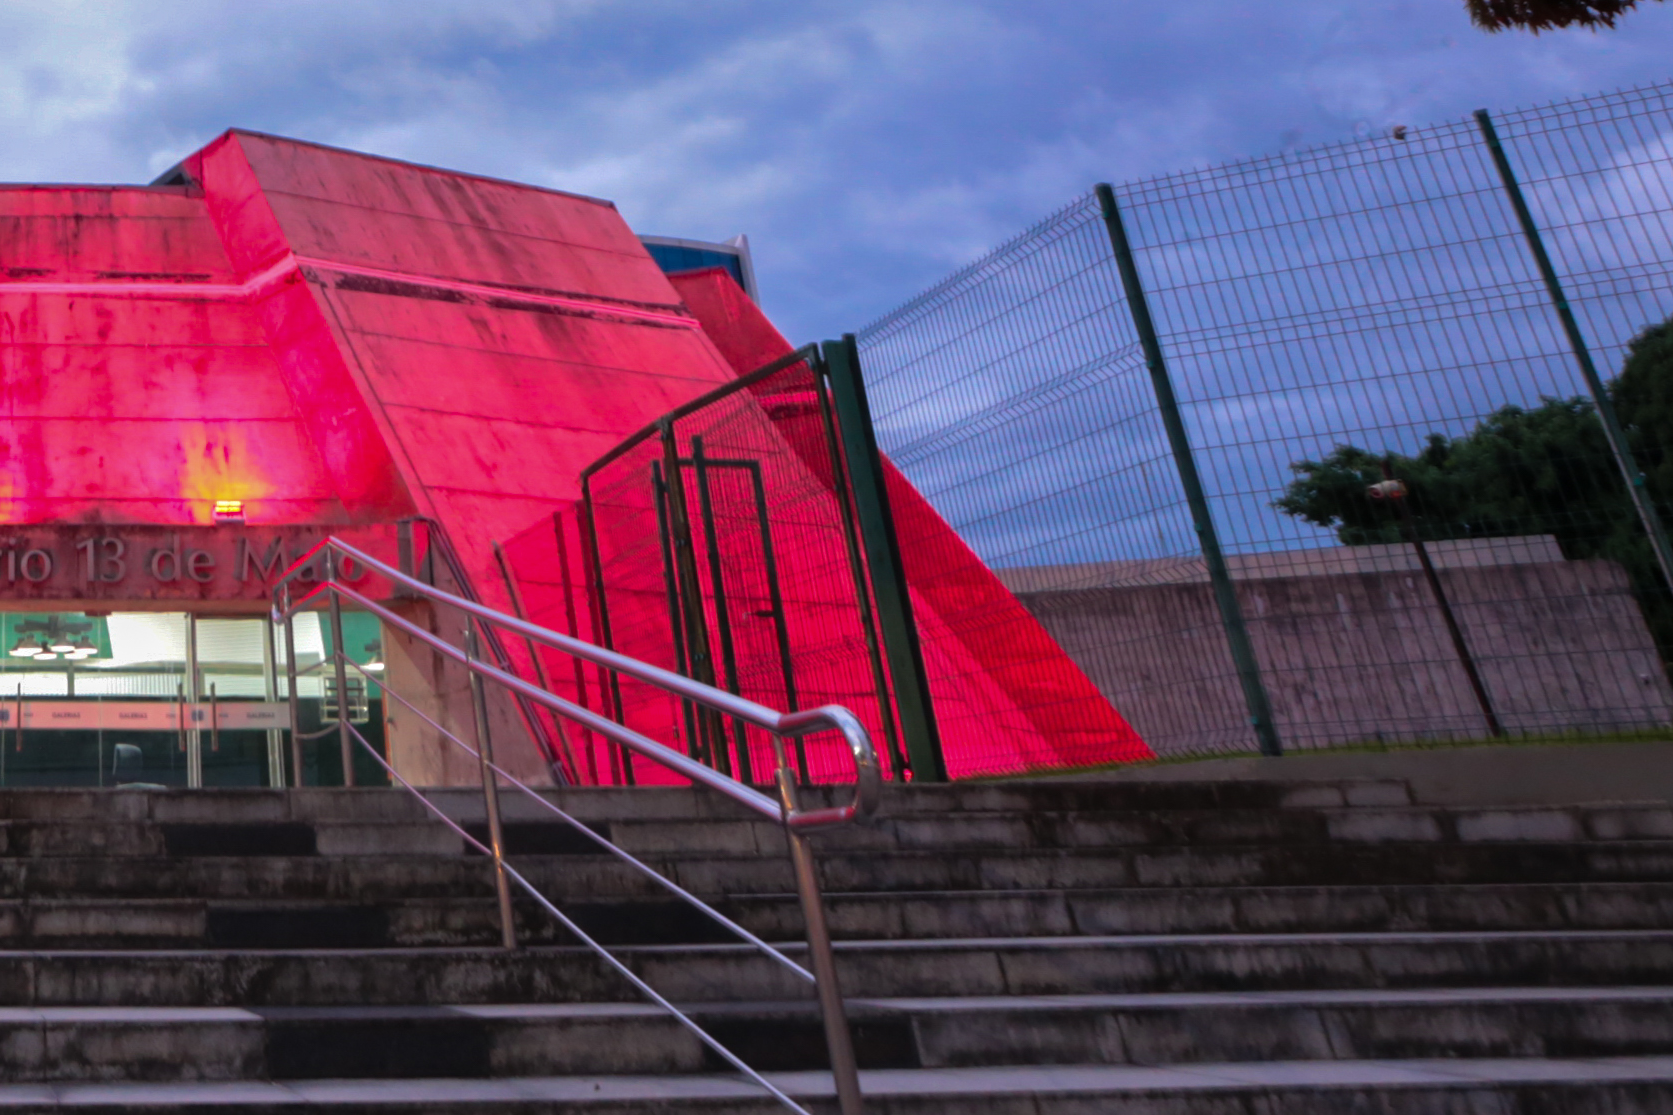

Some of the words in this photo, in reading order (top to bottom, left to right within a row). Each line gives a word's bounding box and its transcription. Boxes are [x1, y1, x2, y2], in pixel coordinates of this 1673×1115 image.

[75, 537, 126, 582] 13
[150, 534, 215, 582] de
[241, 536, 364, 582] Mao
